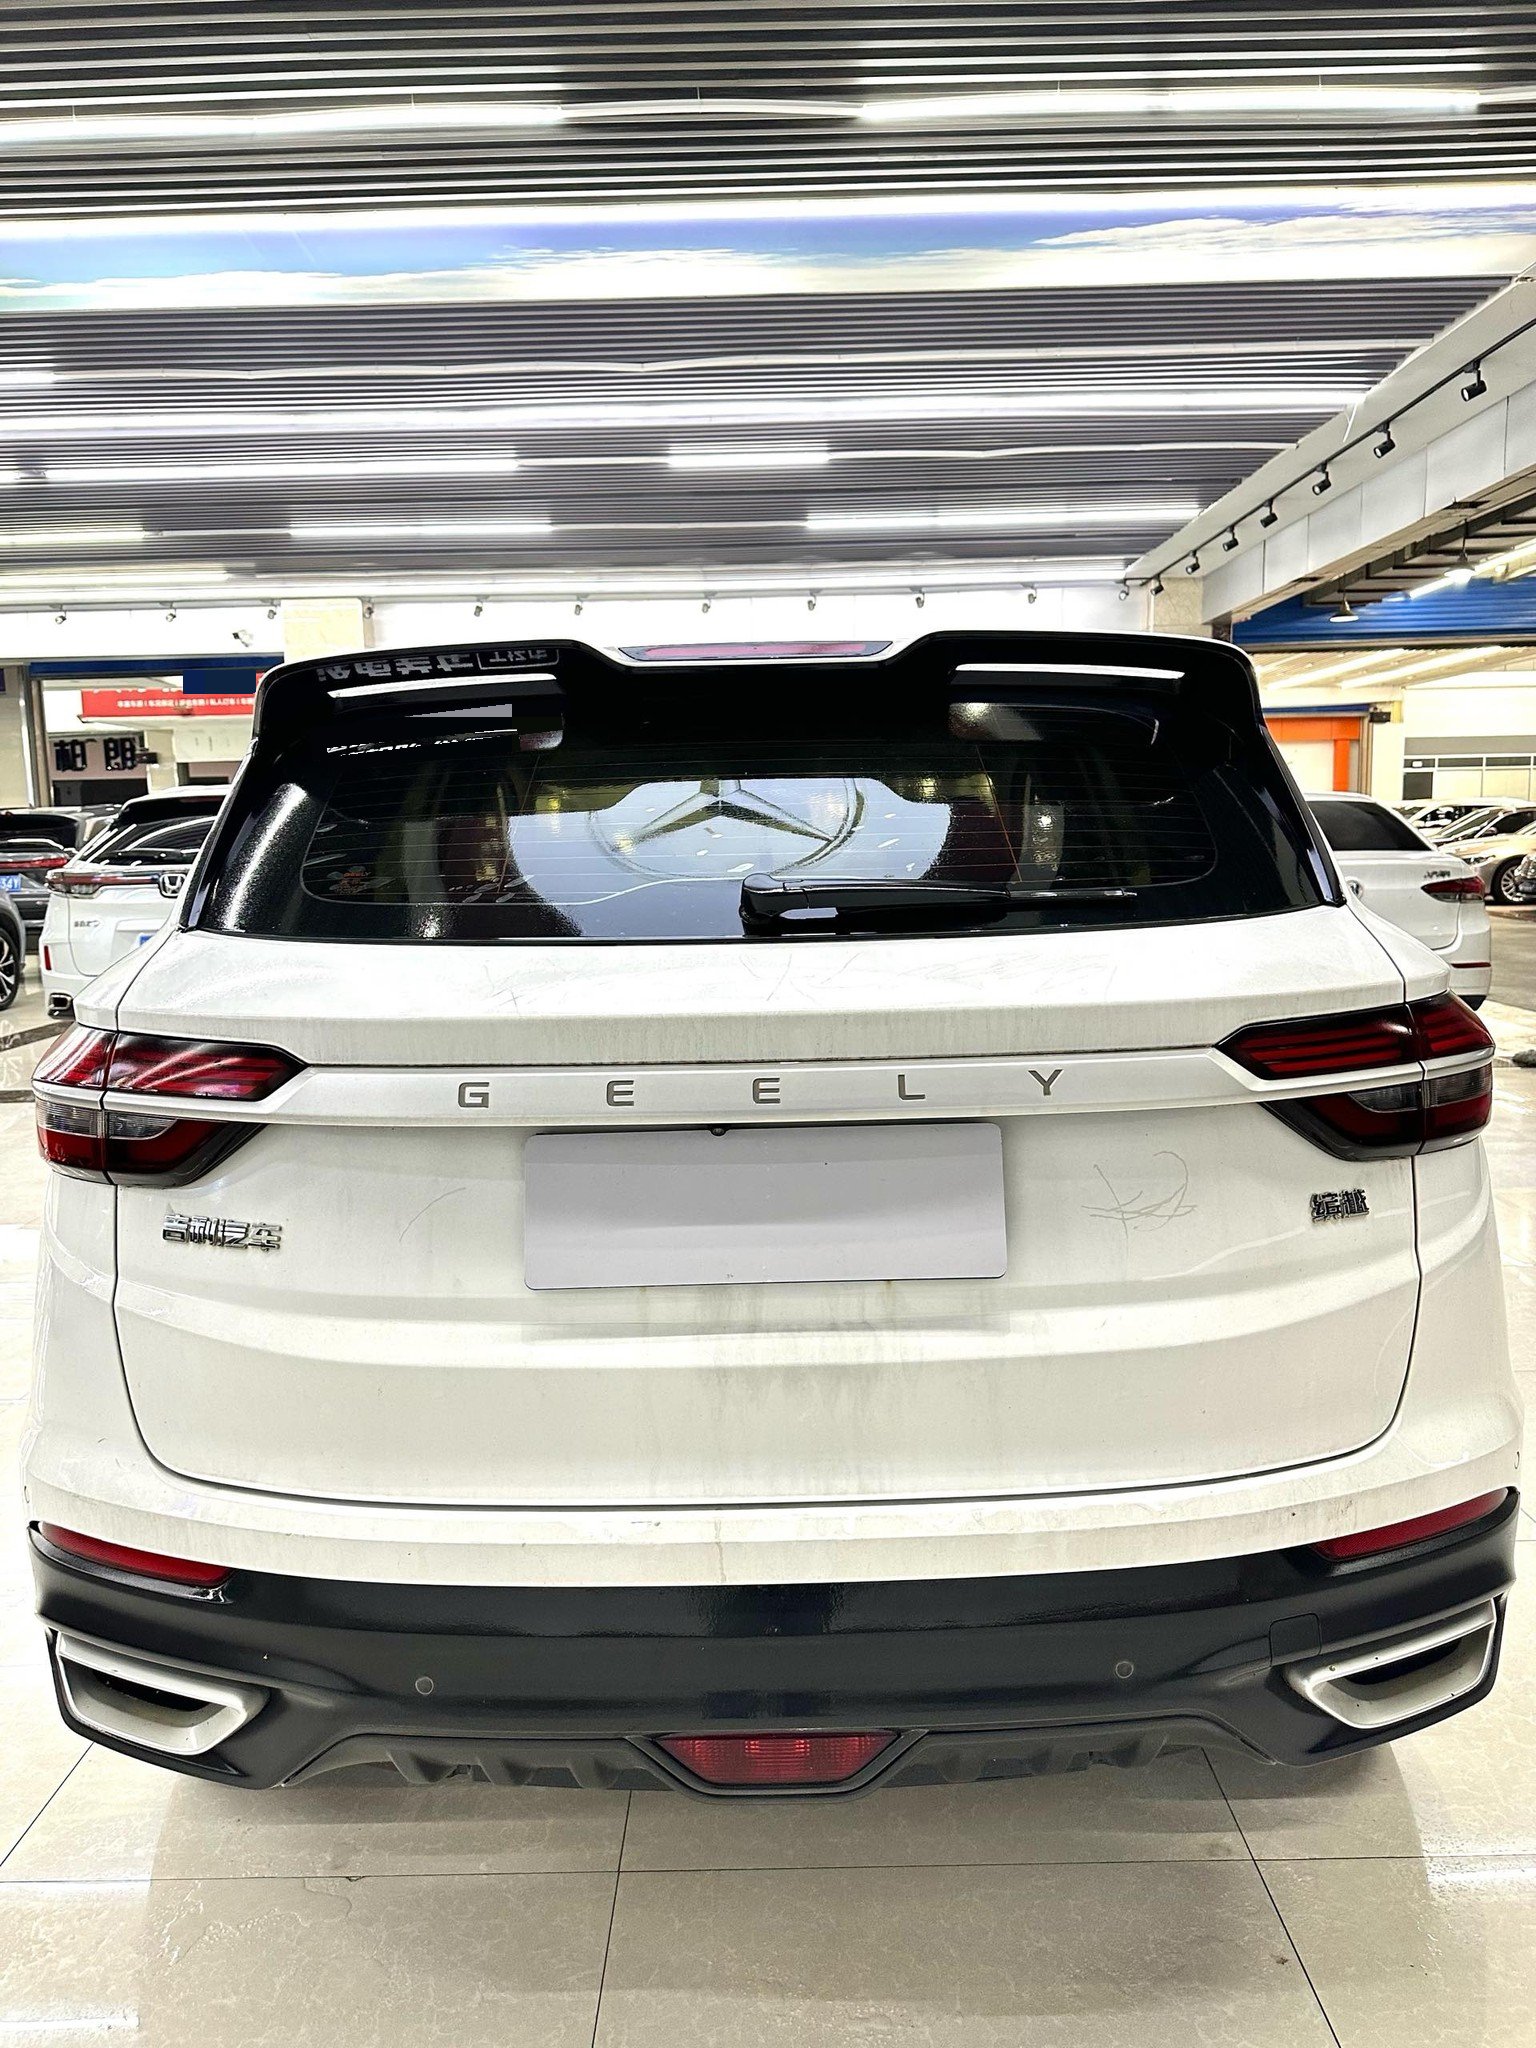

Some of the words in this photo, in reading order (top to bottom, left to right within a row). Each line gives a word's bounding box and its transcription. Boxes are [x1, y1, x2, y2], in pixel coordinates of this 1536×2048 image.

[457, 1068, 1063, 1109] GEELY
[1309, 1188, 1370, 1223] 缤越
[162, 1214, 282, 1252] 吉利汽车
